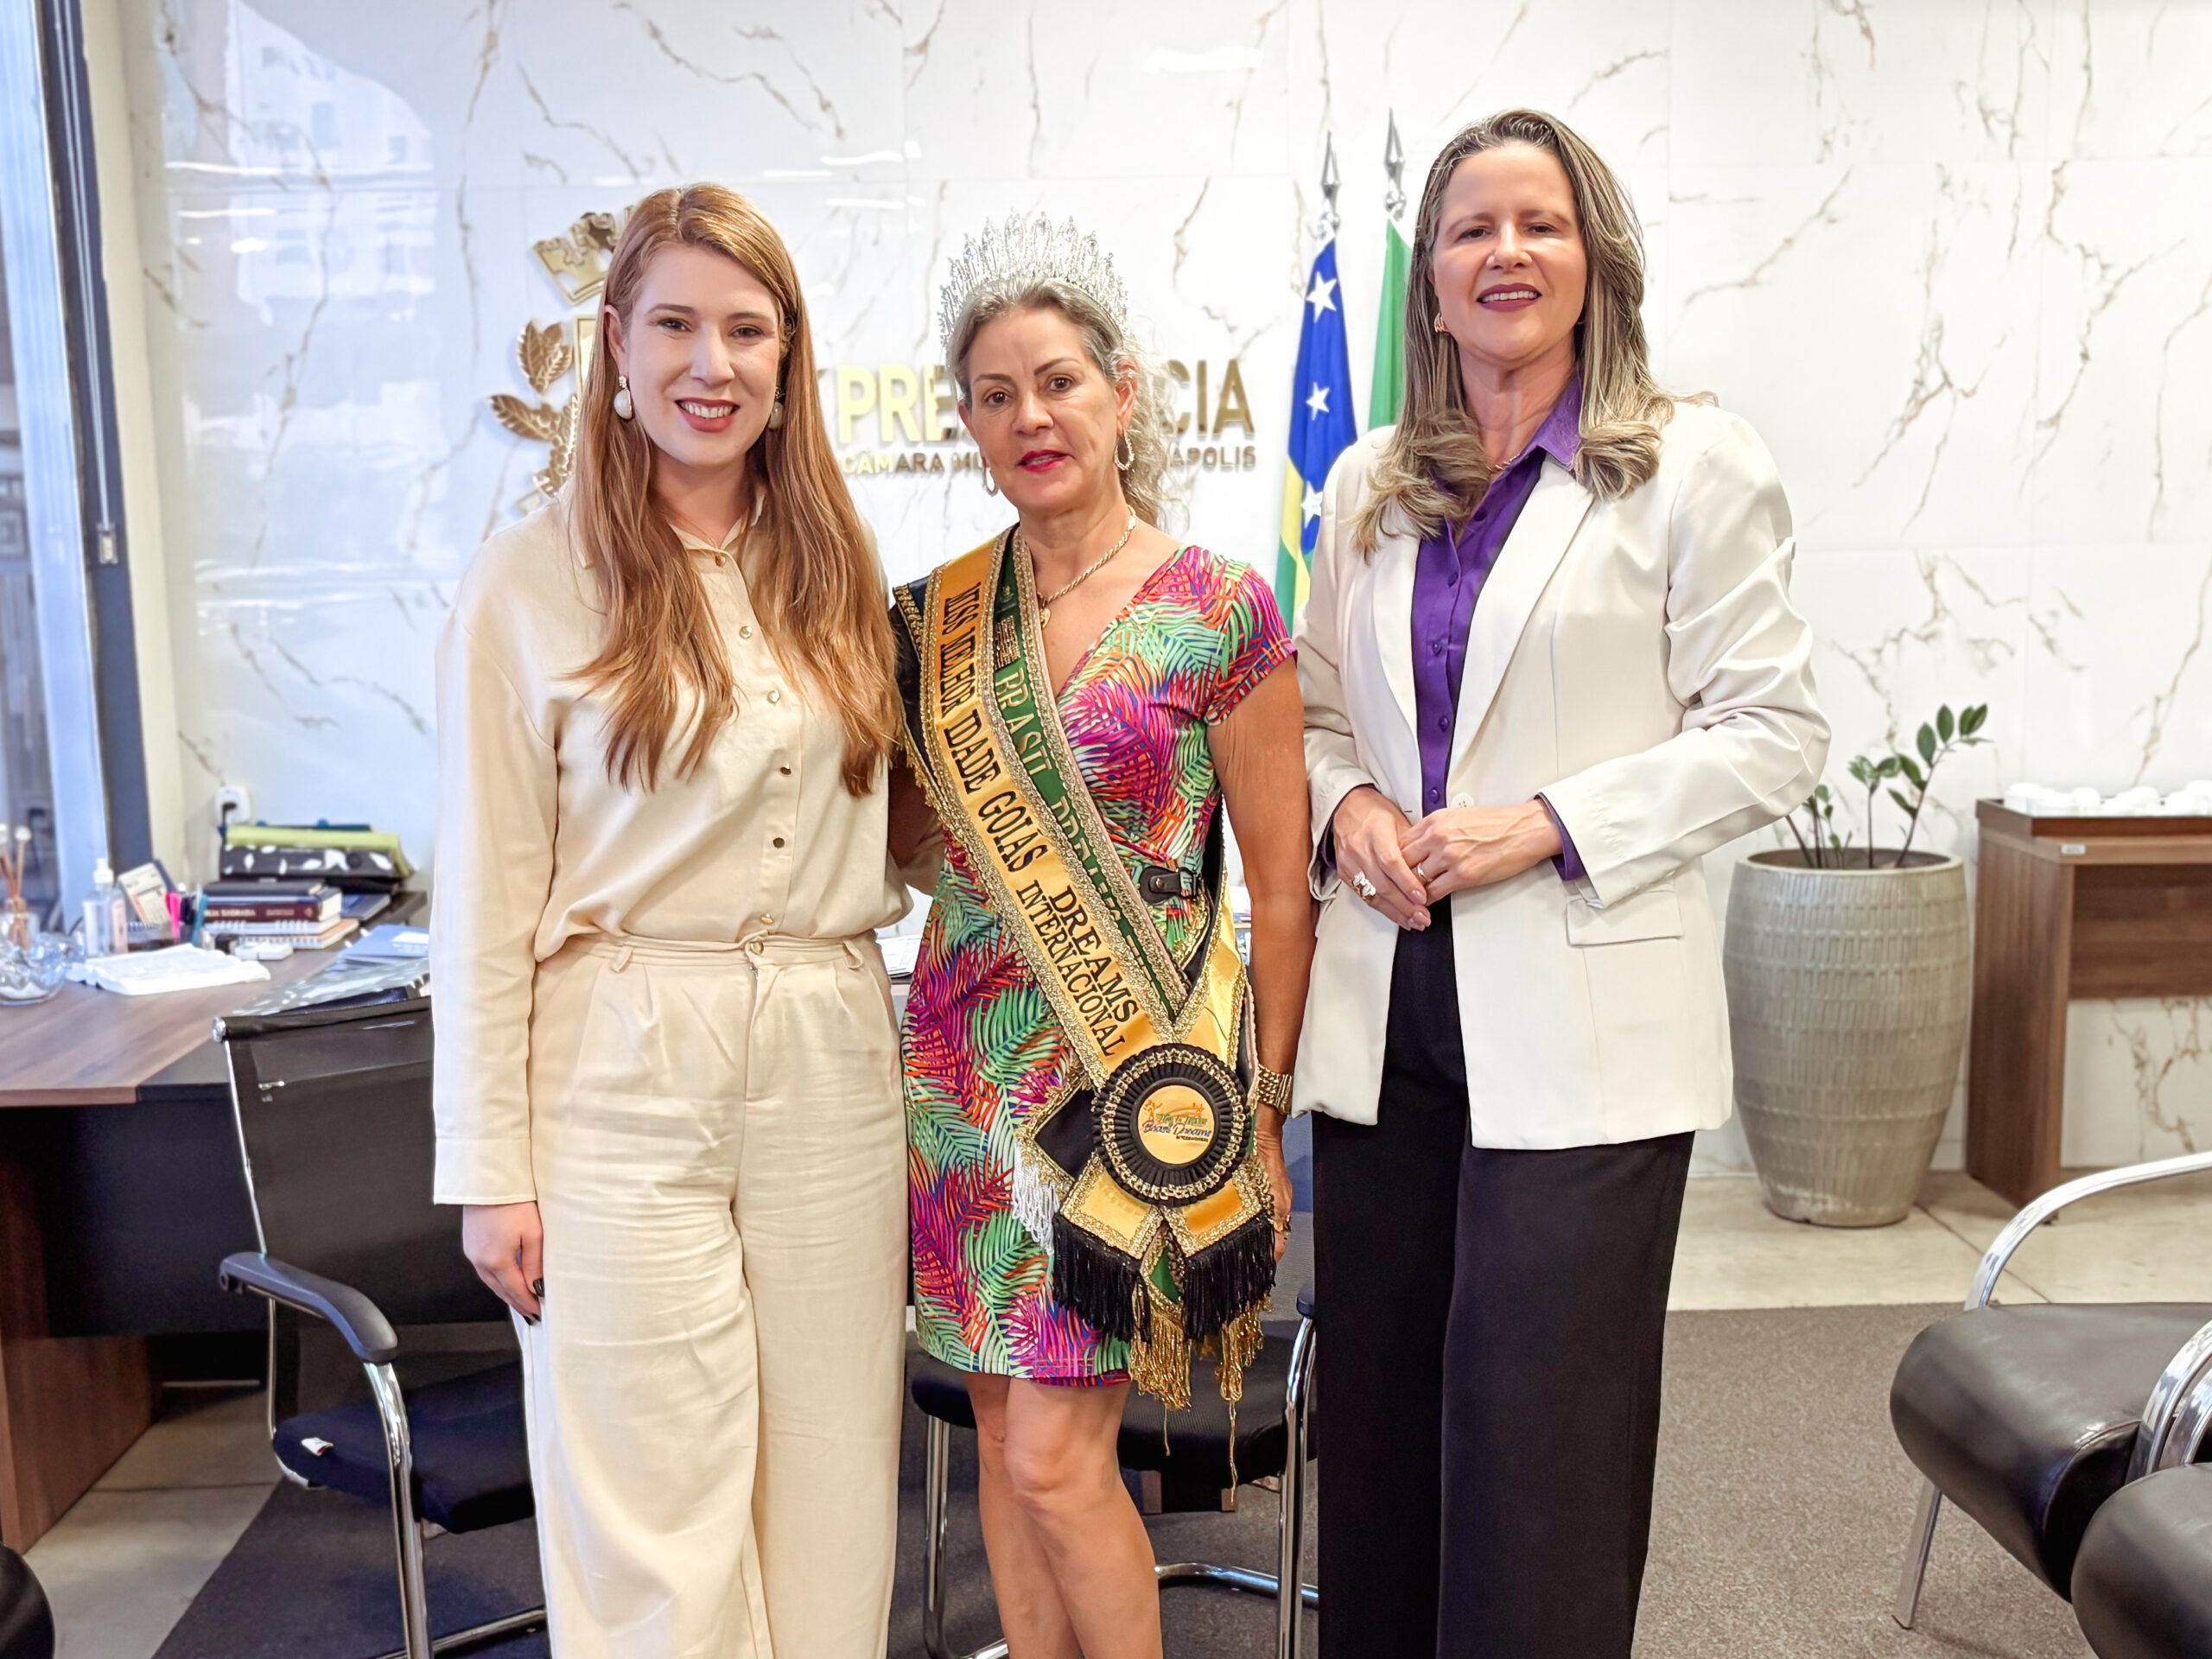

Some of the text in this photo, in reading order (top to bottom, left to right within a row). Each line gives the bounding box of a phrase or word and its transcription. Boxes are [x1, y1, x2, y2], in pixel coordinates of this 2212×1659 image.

[939, 582, 1048, 873] MISS MELHOR IDADE GOIÁS
[1016, 880, 1126, 1057] INTERNACIONAL
[1049, 885, 1140, 1024] DREAMS
